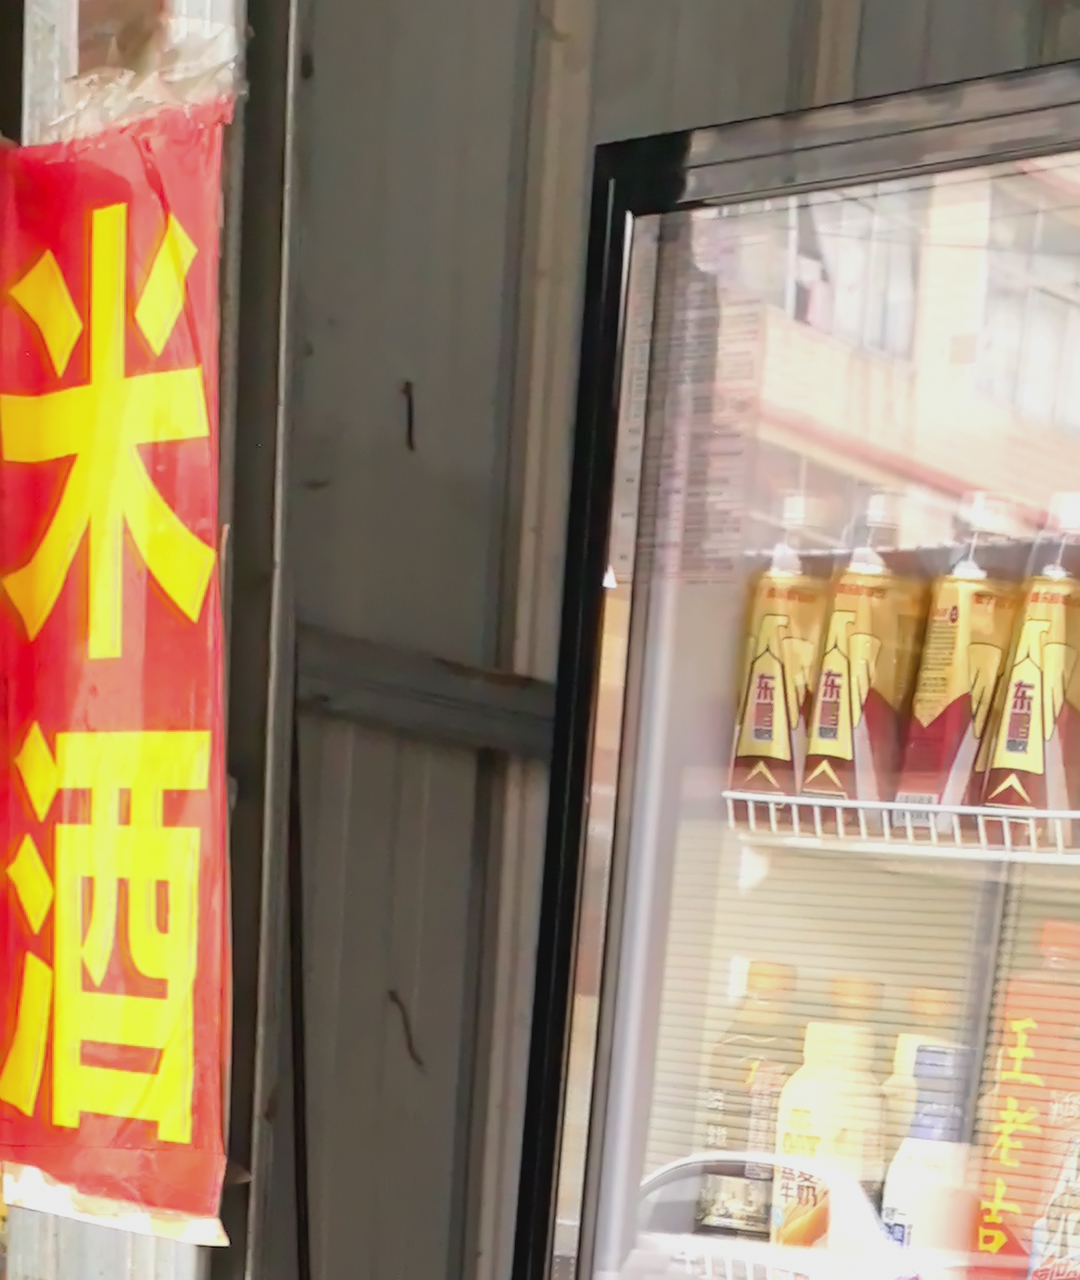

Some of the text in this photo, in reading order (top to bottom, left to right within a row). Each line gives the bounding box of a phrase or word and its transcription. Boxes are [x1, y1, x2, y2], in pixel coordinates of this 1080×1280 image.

[0, 203, 216, 1143] 米酒
[978, 1017, 1044, 1253] 王老吉
